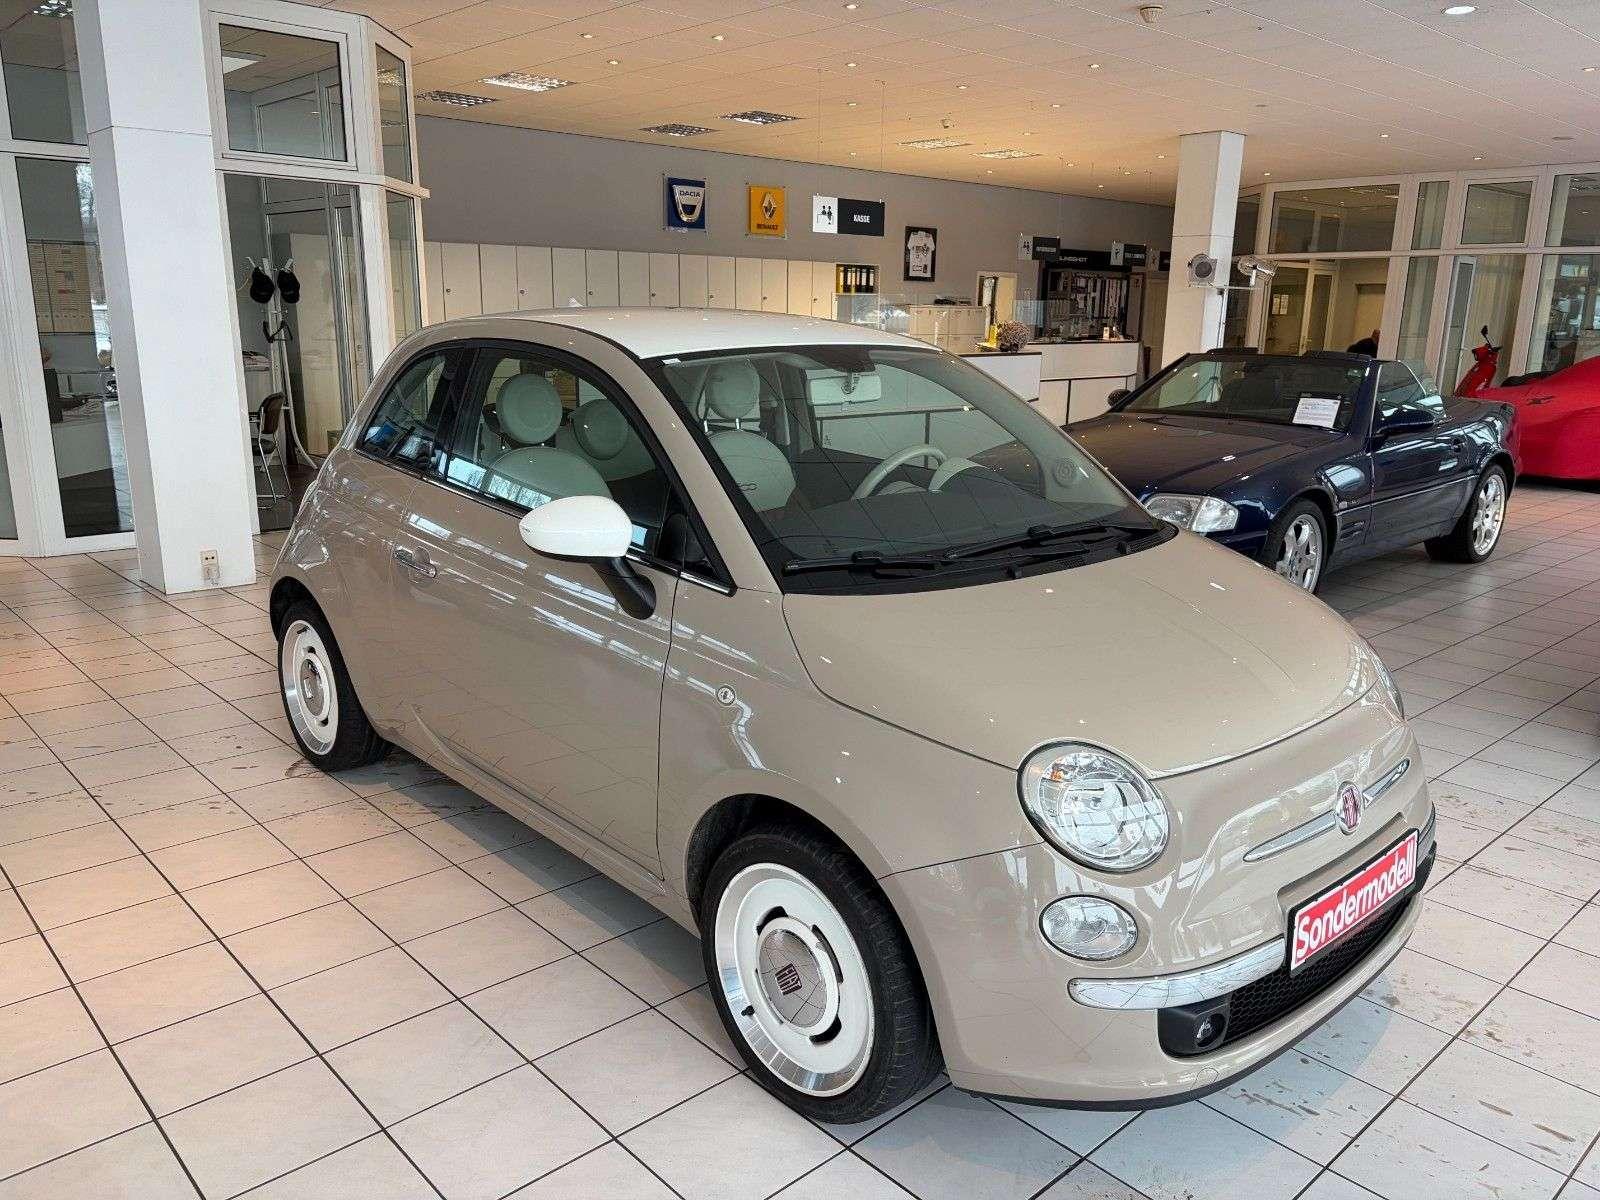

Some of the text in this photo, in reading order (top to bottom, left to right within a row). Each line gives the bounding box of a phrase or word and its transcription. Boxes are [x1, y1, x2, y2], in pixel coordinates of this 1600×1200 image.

[679, 190, 701, 198] DACIA
[853, 214, 871, 224] KASSE
[1296, 841, 1414, 958] Sondermodell
